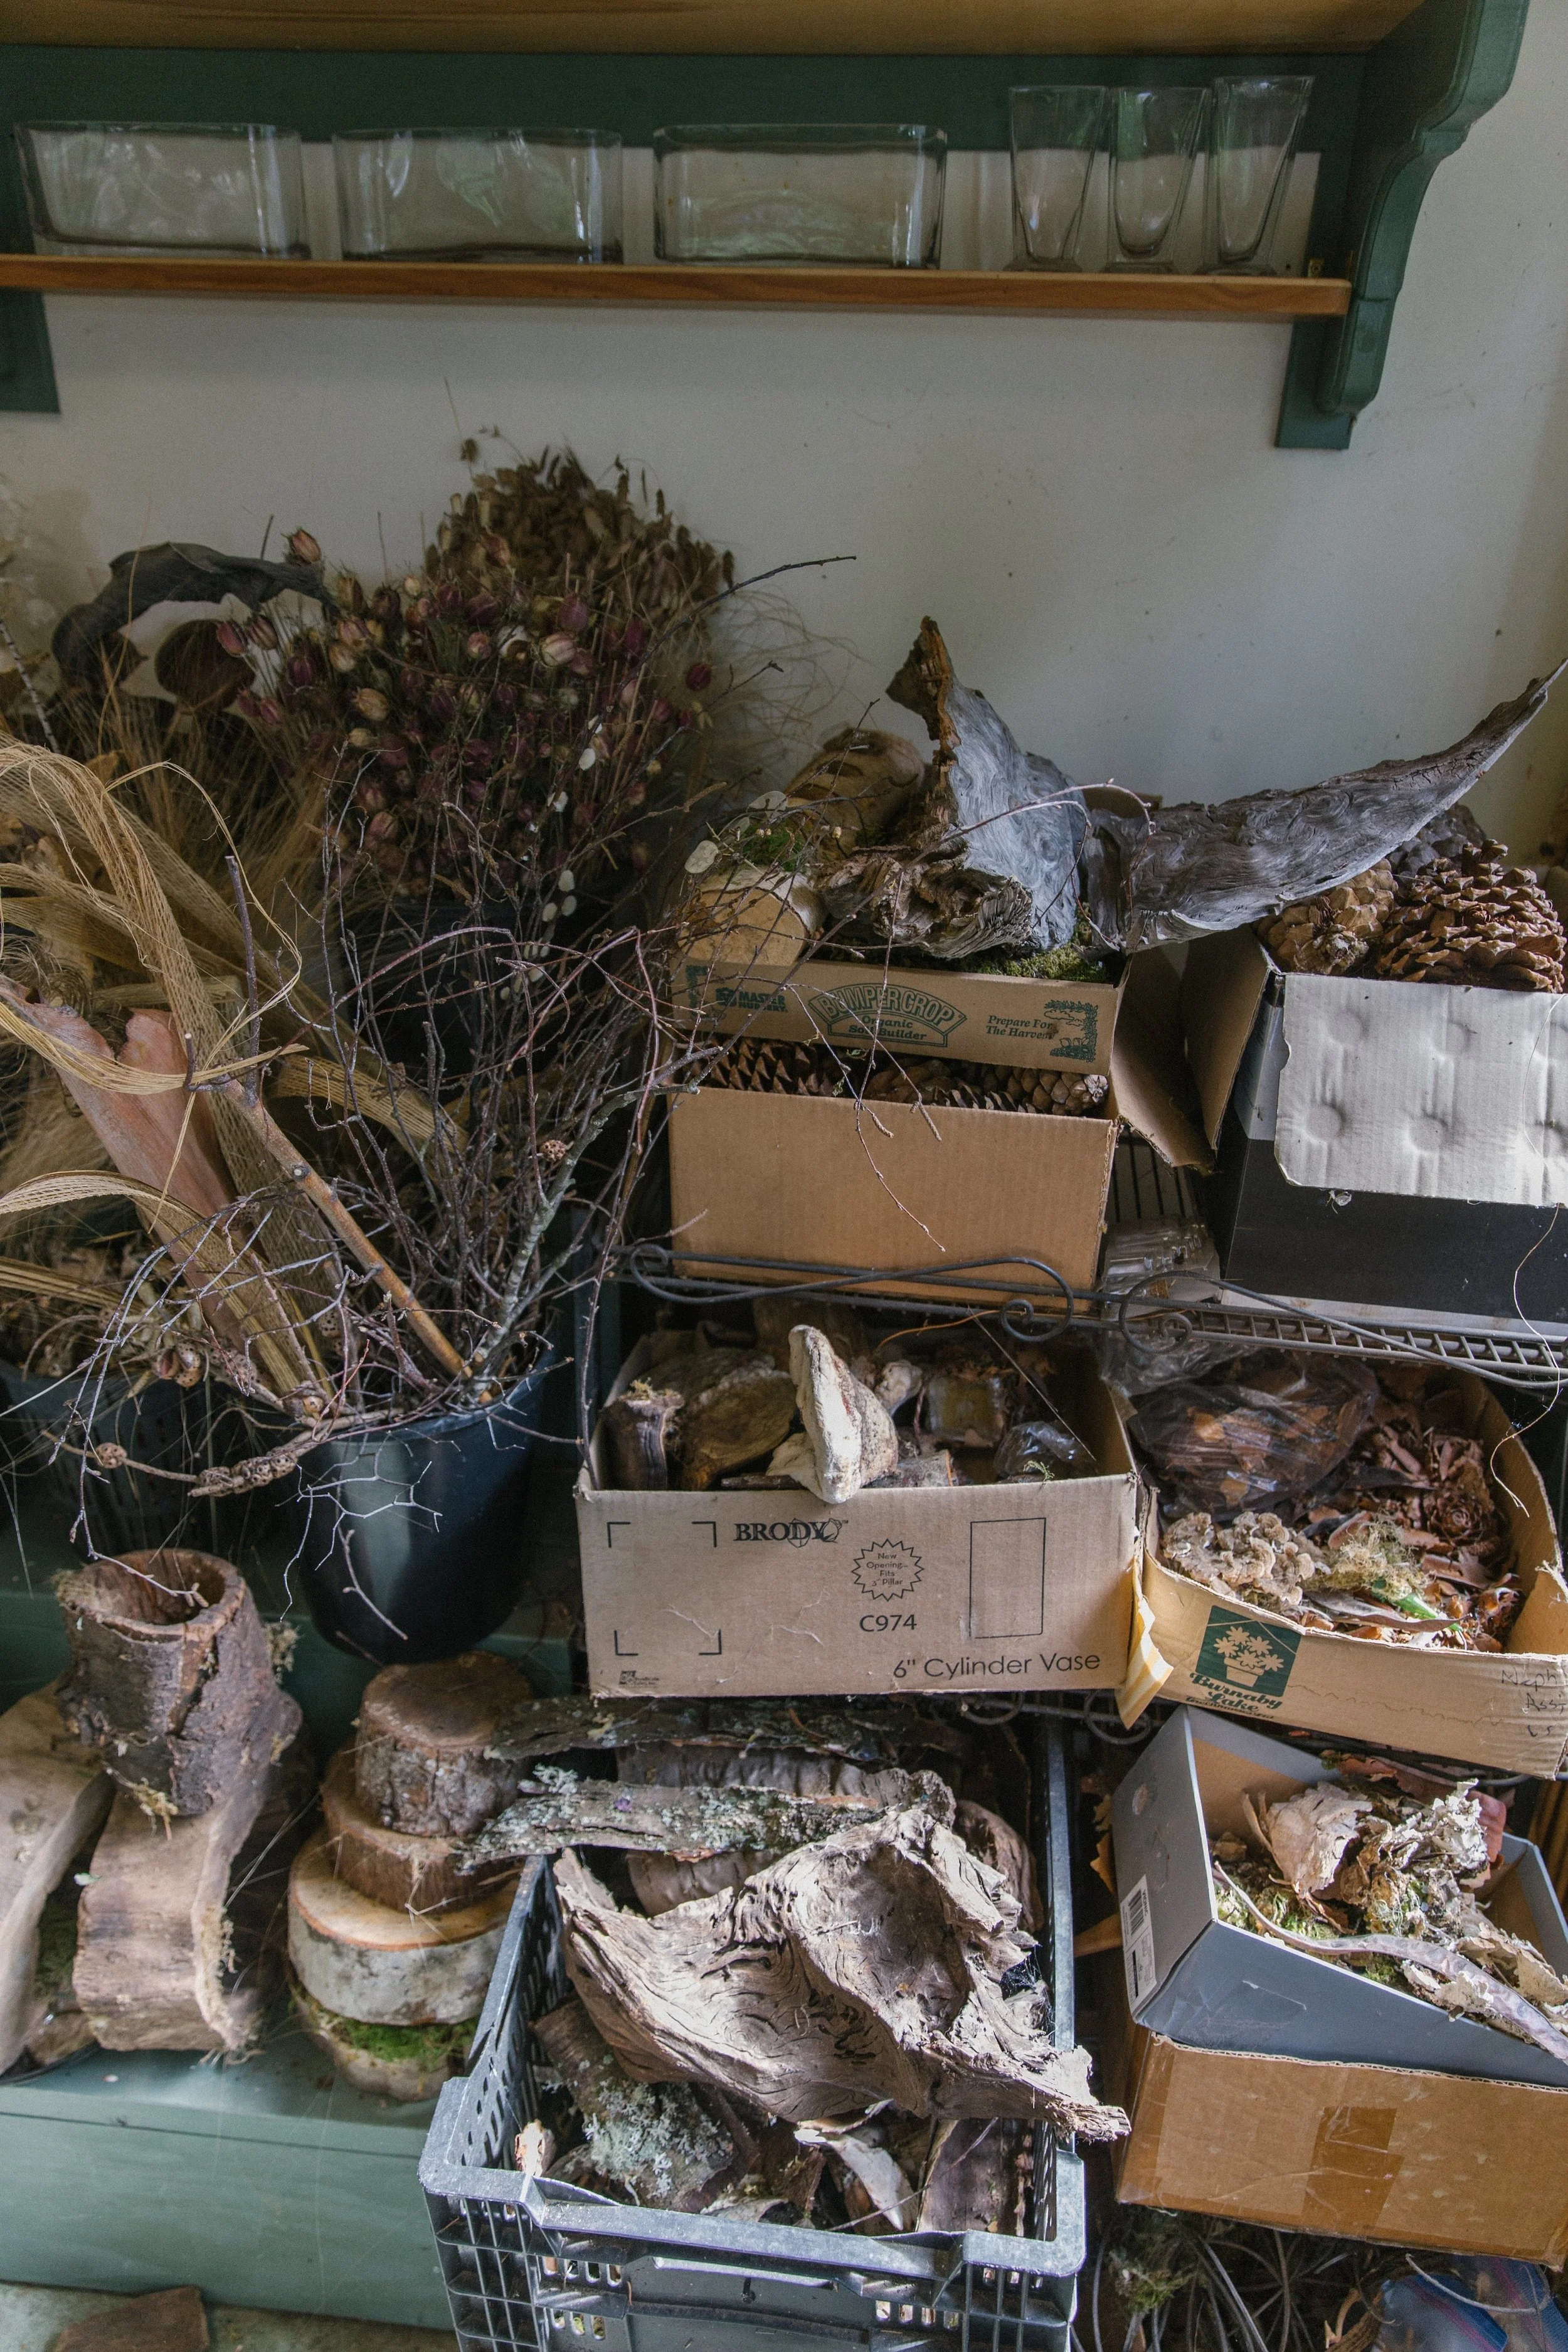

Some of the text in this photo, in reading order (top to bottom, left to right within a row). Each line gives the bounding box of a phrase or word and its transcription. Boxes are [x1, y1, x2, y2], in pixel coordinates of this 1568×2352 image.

[862, 1014, 913, 1029] Organic
[986, 1025, 1006, 1035] The
[988, 1015, 1053, 1029] Prepare For
[878, 1027, 927, 1041] Builder
[733, 1521, 829, 1542] BRODY
[859, 1614, 917, 1632] C974
[893, 1653, 1101, 1680] 6" Cylinder Vase
[1189, 1672, 1283, 1710] Burnaby
[1208, 1691, 1259, 1712] Lake
